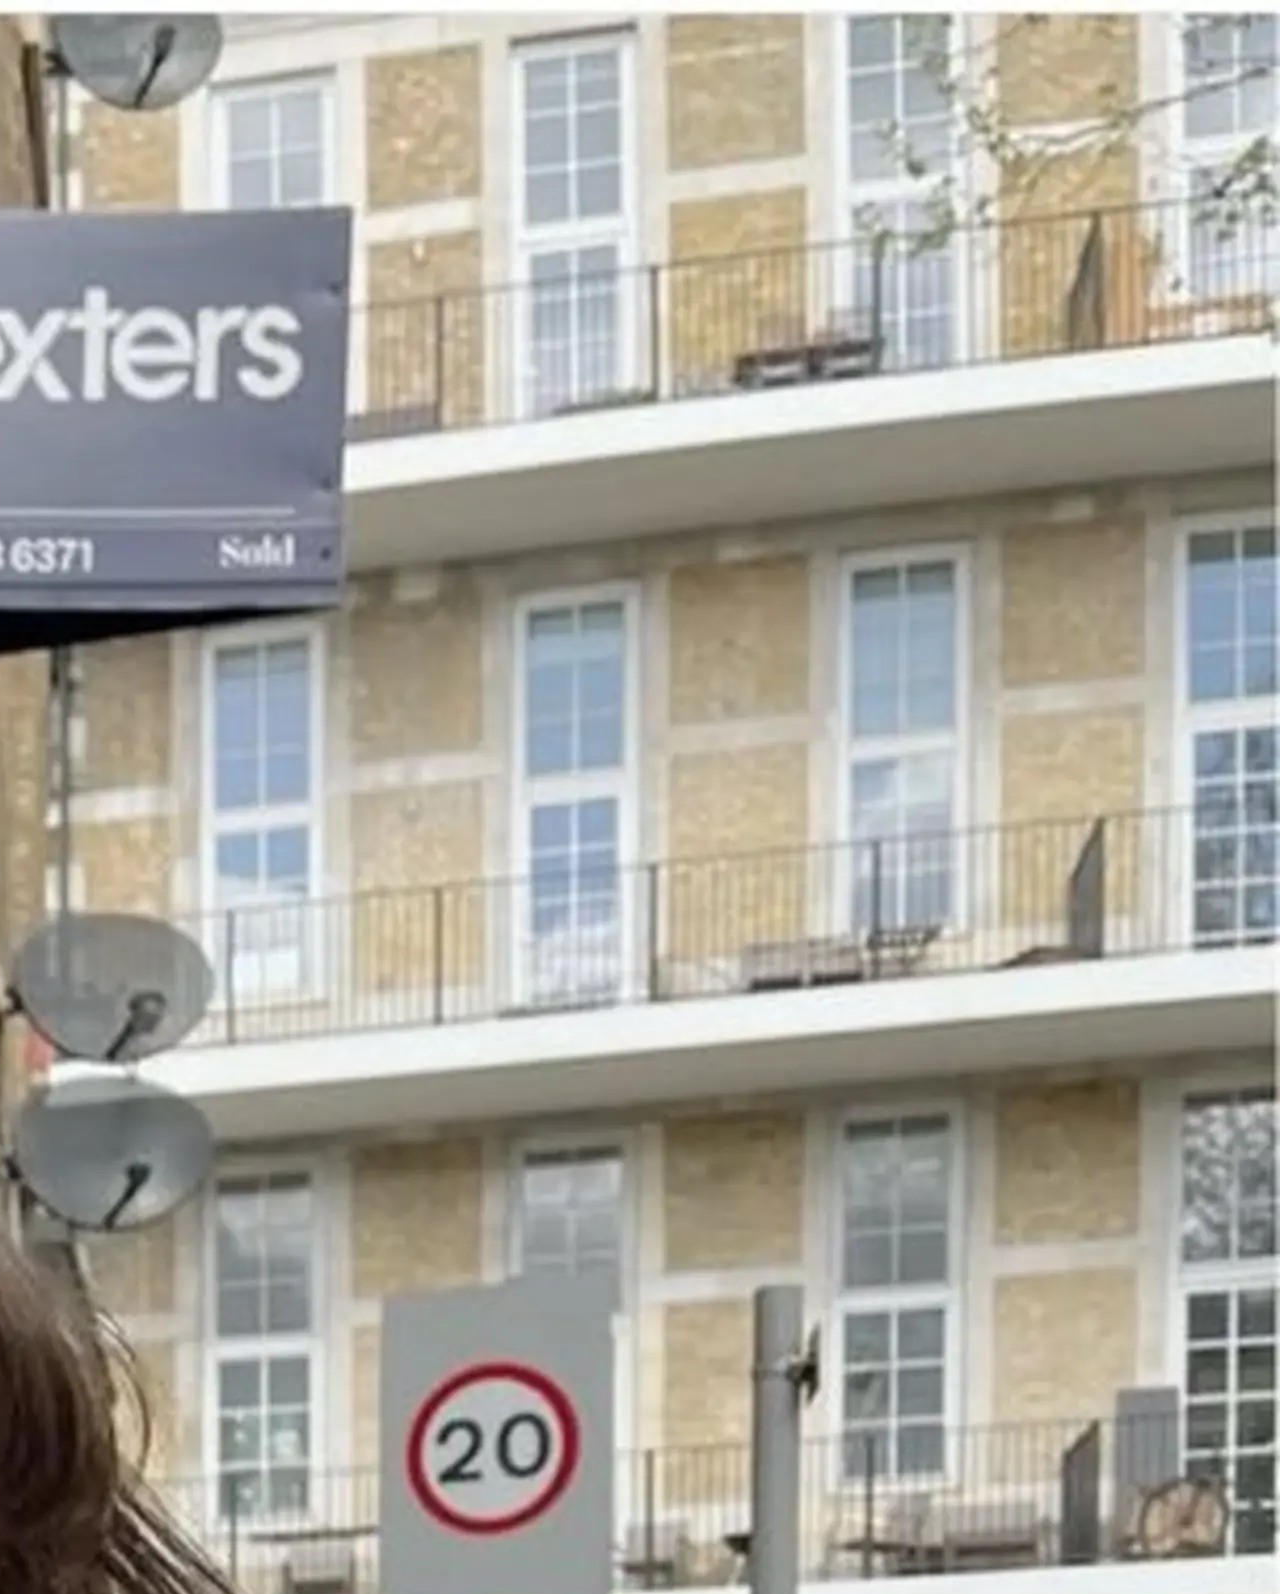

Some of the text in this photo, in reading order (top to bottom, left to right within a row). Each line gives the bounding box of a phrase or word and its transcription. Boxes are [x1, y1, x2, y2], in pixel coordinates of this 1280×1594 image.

[10, 536, 94, 574] 6371
[219, 533, 296, 570] Sold
[435, 1412, 552, 1485] 20
